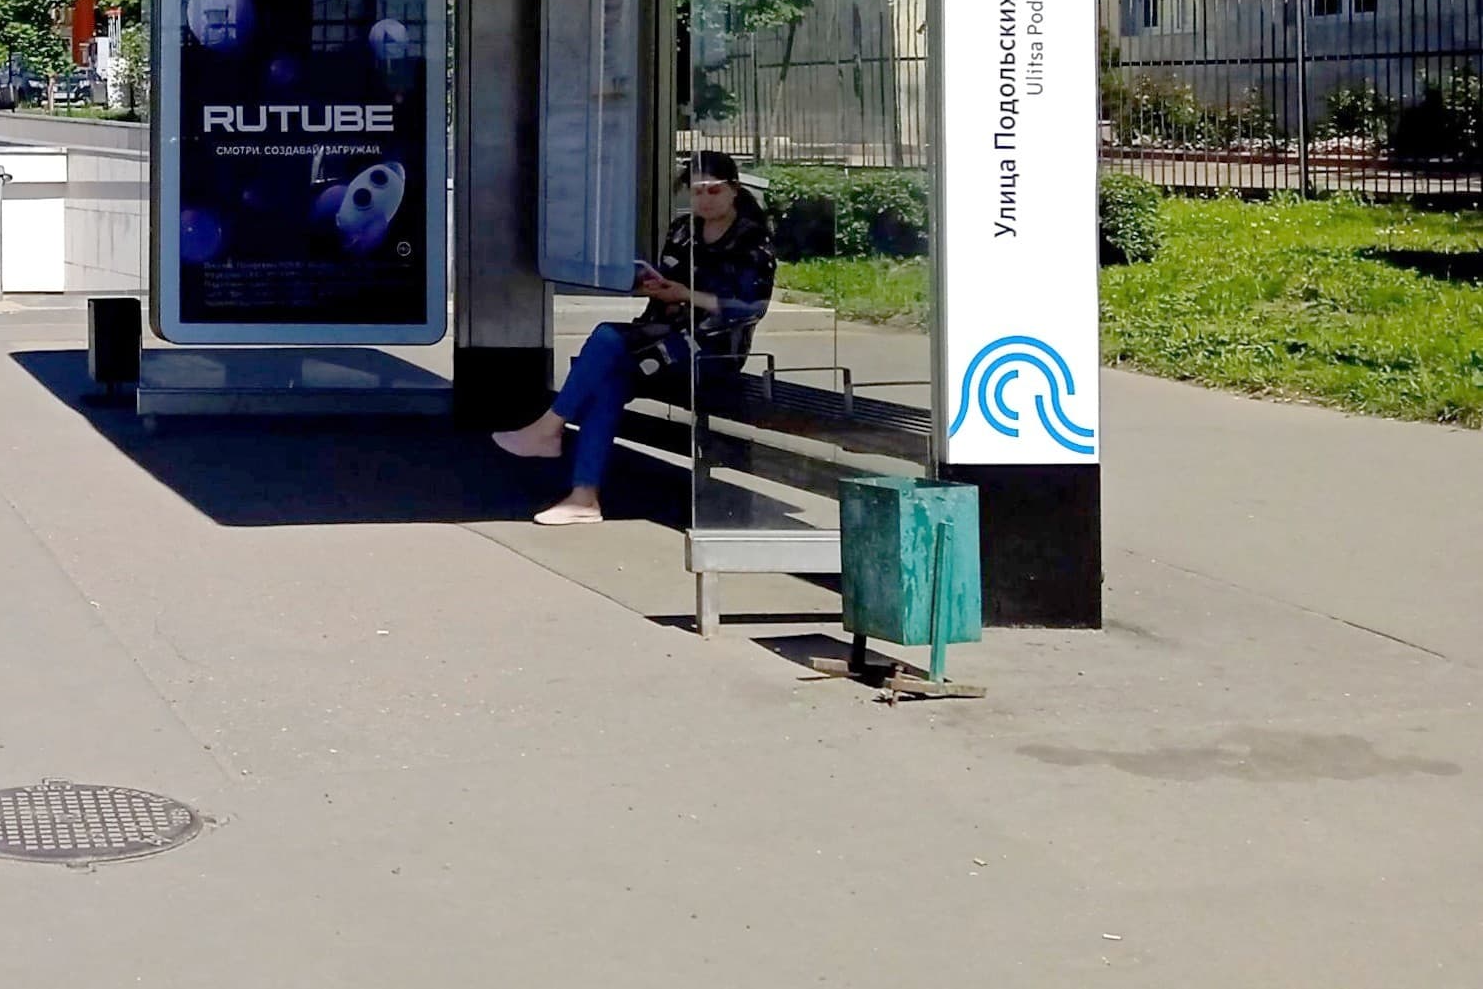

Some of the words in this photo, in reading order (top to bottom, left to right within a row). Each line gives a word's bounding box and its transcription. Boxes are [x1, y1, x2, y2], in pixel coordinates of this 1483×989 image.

[1025, 41, 1044, 96] Ulitsa
[203, 104, 395, 133] RUTUBE
[994, 159, 1020, 238] Улица
